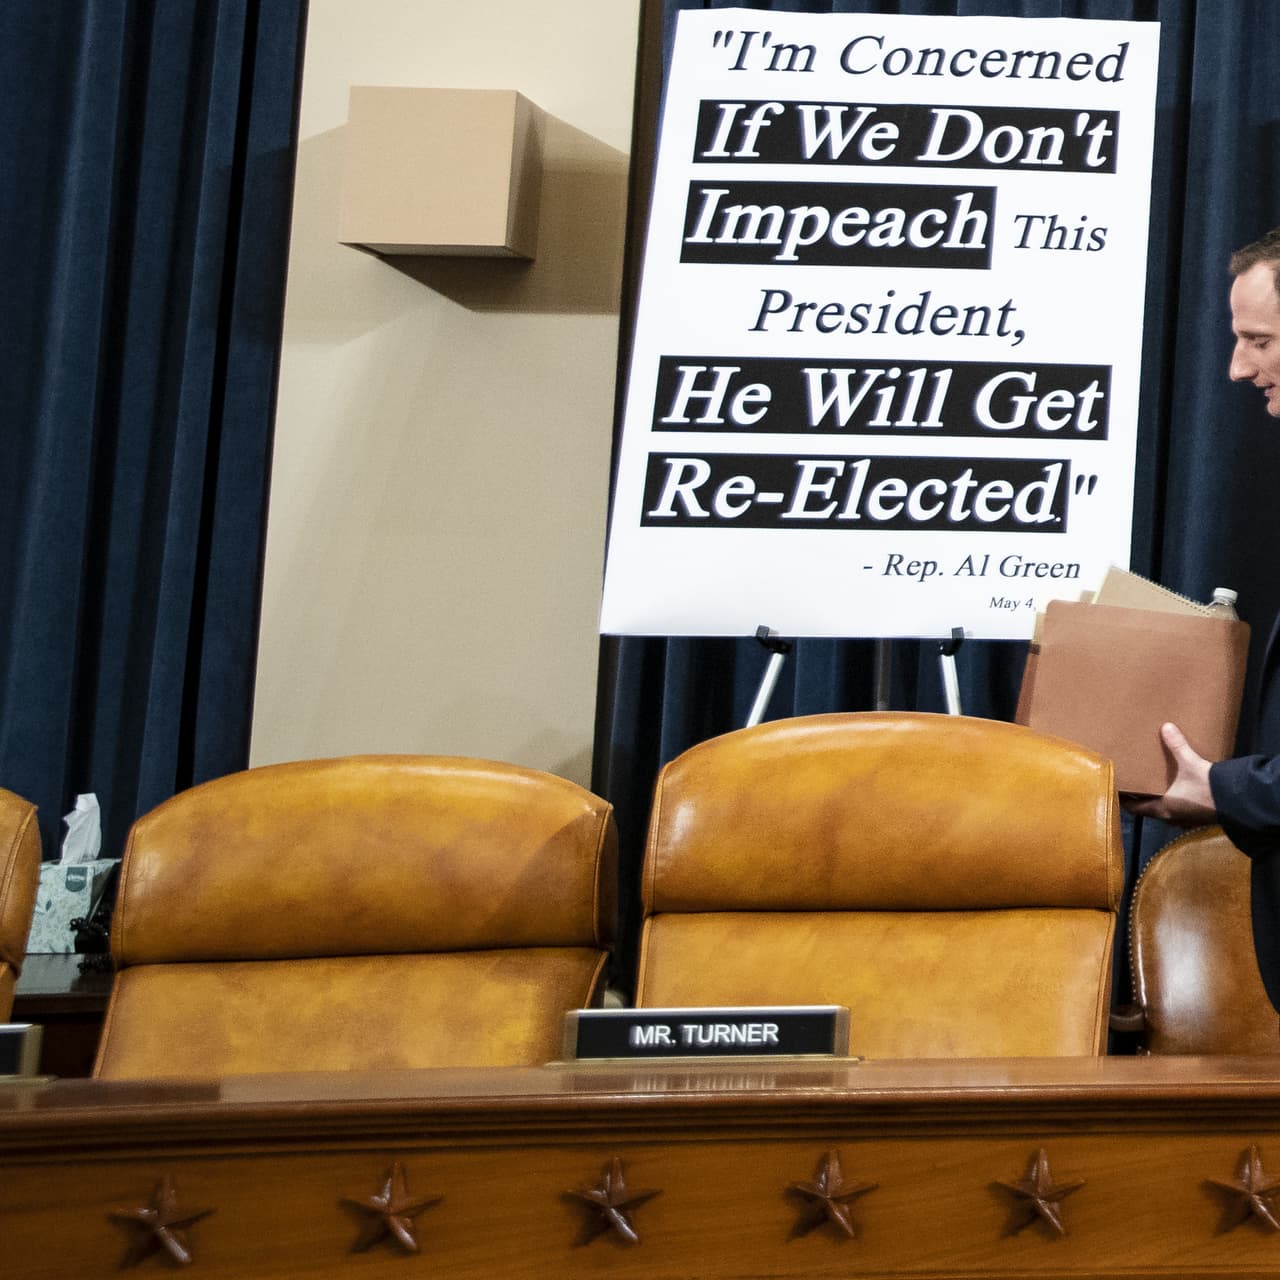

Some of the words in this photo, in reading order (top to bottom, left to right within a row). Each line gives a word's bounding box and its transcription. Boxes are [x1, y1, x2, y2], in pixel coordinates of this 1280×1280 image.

[712, 30, 817, 73] "I'm
[839, 35, 1130, 83] Concerned
[702, 102, 785, 157] If
[797, 104, 900, 161] We
[917, 108, 1113, 167] Don't
[683, 188, 988, 261] Impeach
[1013, 214, 1108, 252] This
[747, 289, 1025, 347] President,
[661, 365, 772, 425] He
[802, 367, 953, 428] Will
[975, 371, 1105, 432] Get
[882, 553, 944, 583] Rep.
[953, 554, 990, 577] Al
[999, 555, 1081, 579] Green
[989, 596, 1021, 612] May
[634, 1025, 676, 1045] MR.
[682, 1023, 779, 1044] TURNER
